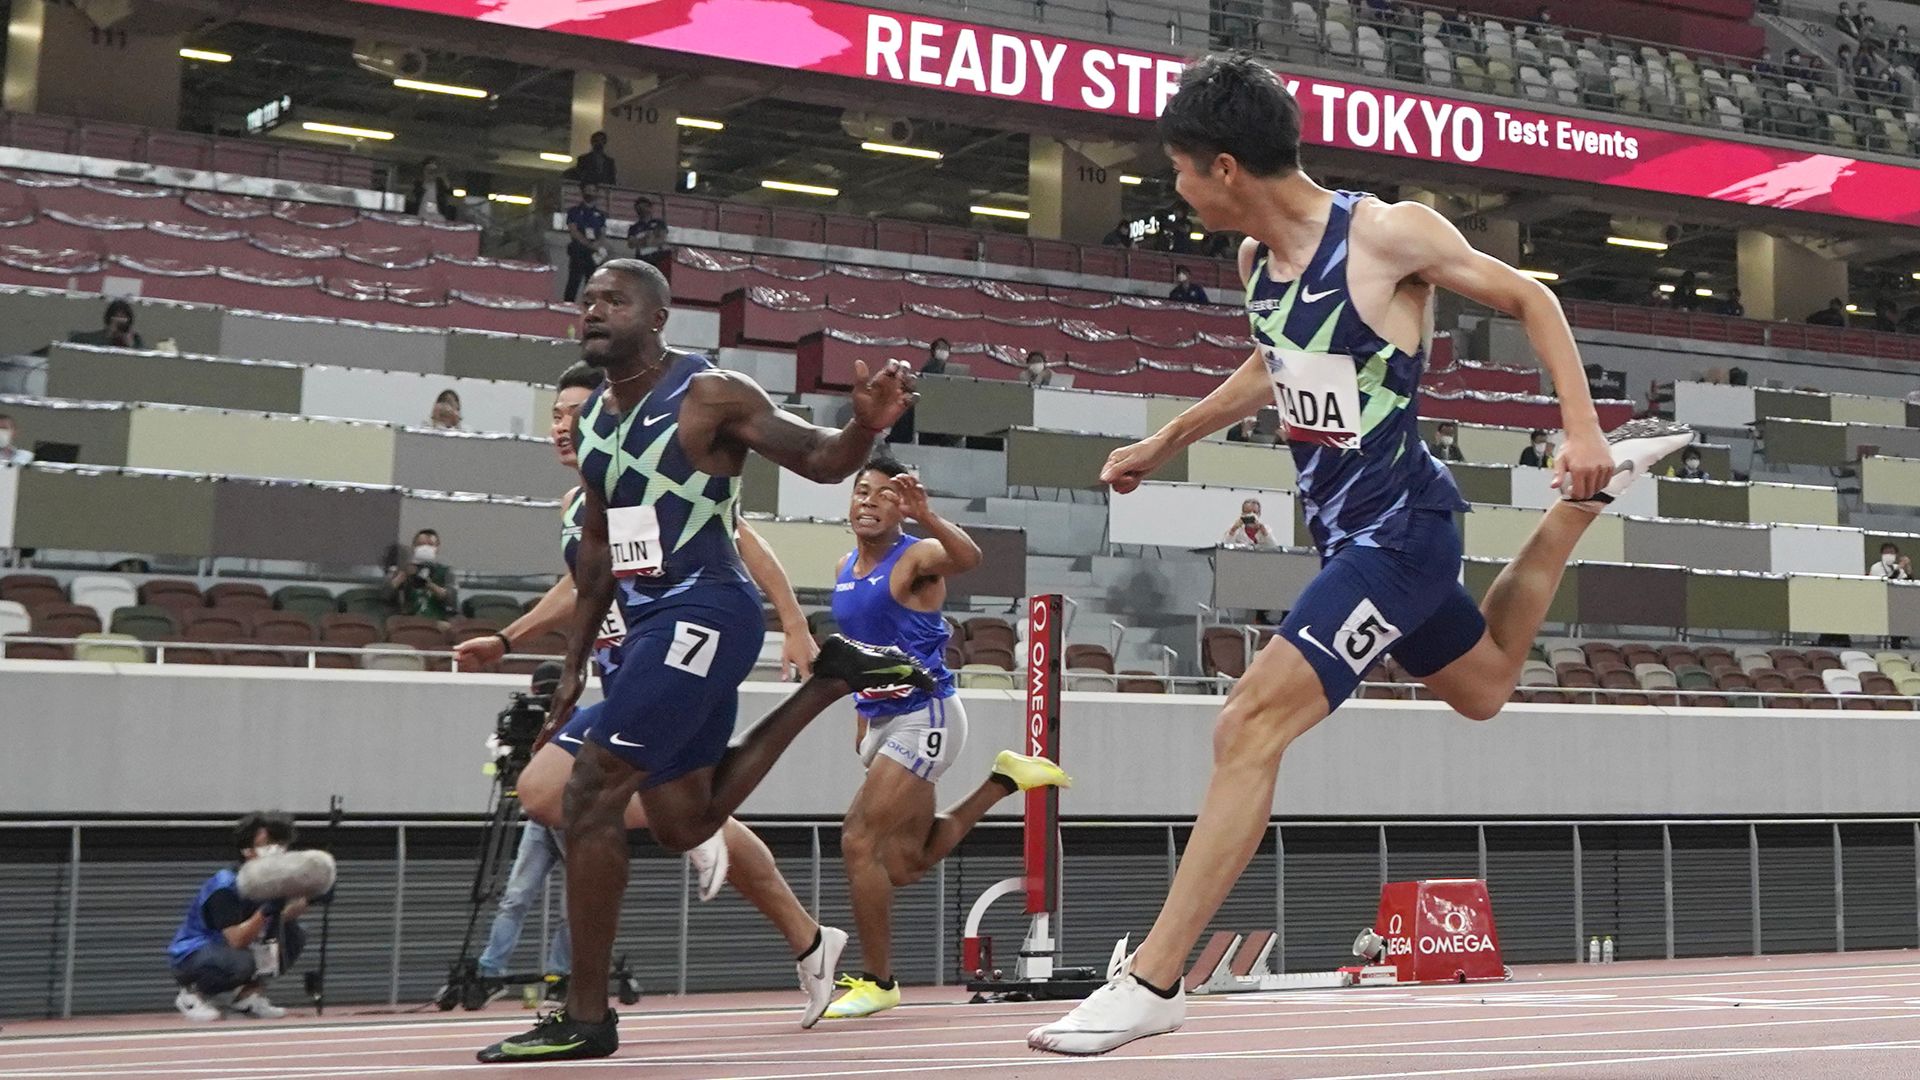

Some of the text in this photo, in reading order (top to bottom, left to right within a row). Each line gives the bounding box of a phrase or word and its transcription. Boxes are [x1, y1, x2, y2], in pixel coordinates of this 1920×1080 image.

[865, 13, 1068, 102] READY
[1312, 83, 1484, 162] TOKYO
[1494, 111, 1549, 147] Test
[1556, 120, 1639, 160] Events
[1077, 165, 1106, 184] 110
[1276, 382, 1345, 429] TADA
[611, 541, 648, 563] TLIN
[681, 627, 710, 667] 7
[1346, 614, 1390, 660] 5
[1031, 641, 1045, 758] OMEGA
[887, 740, 917, 761] OKAI
[926, 731, 942, 758] 9
[1419, 934, 1495, 954] OMEGA
